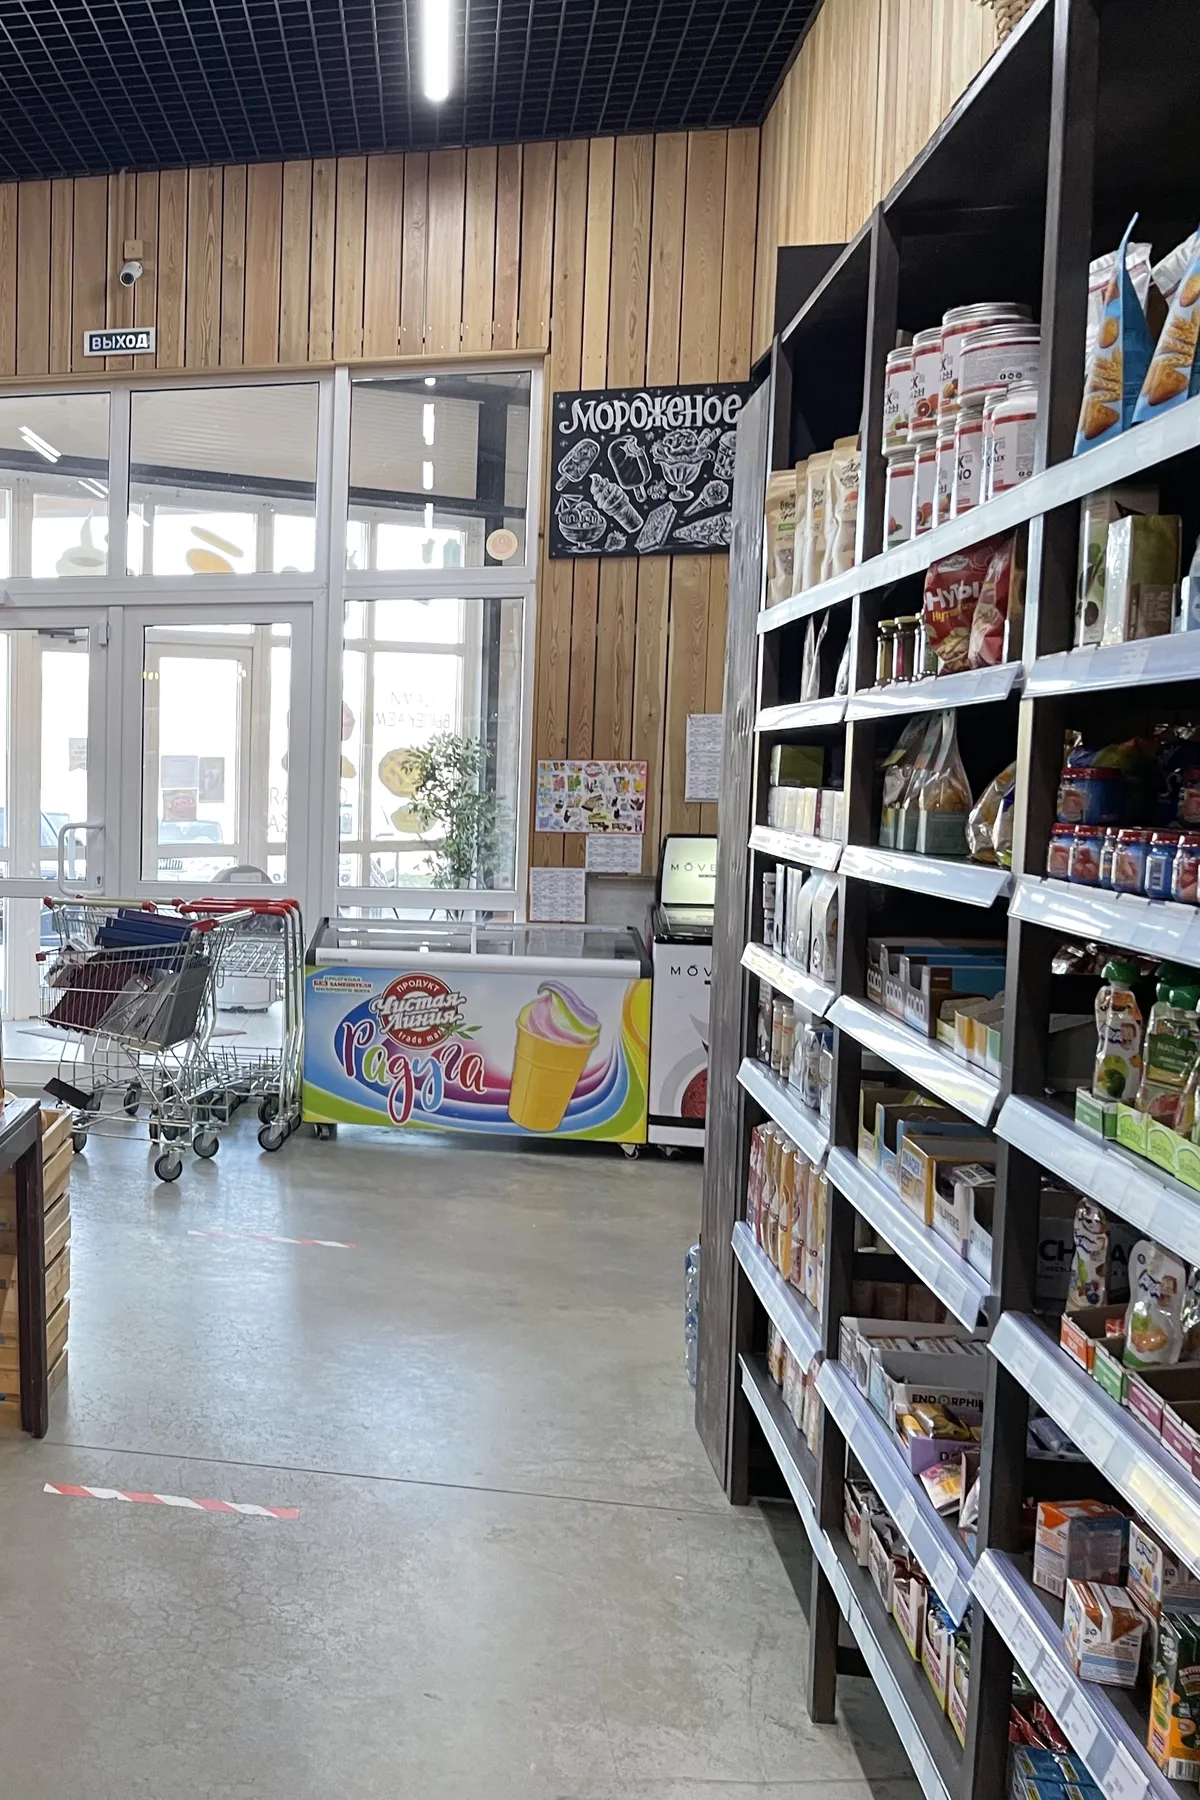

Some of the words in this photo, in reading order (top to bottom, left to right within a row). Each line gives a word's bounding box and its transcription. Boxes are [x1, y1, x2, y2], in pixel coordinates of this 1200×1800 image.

[92, 334, 148, 350] ВЫХОД
[396, 980, 440, 993] ПРОДУКТ
[341, 1020, 488, 1125] Радуга
